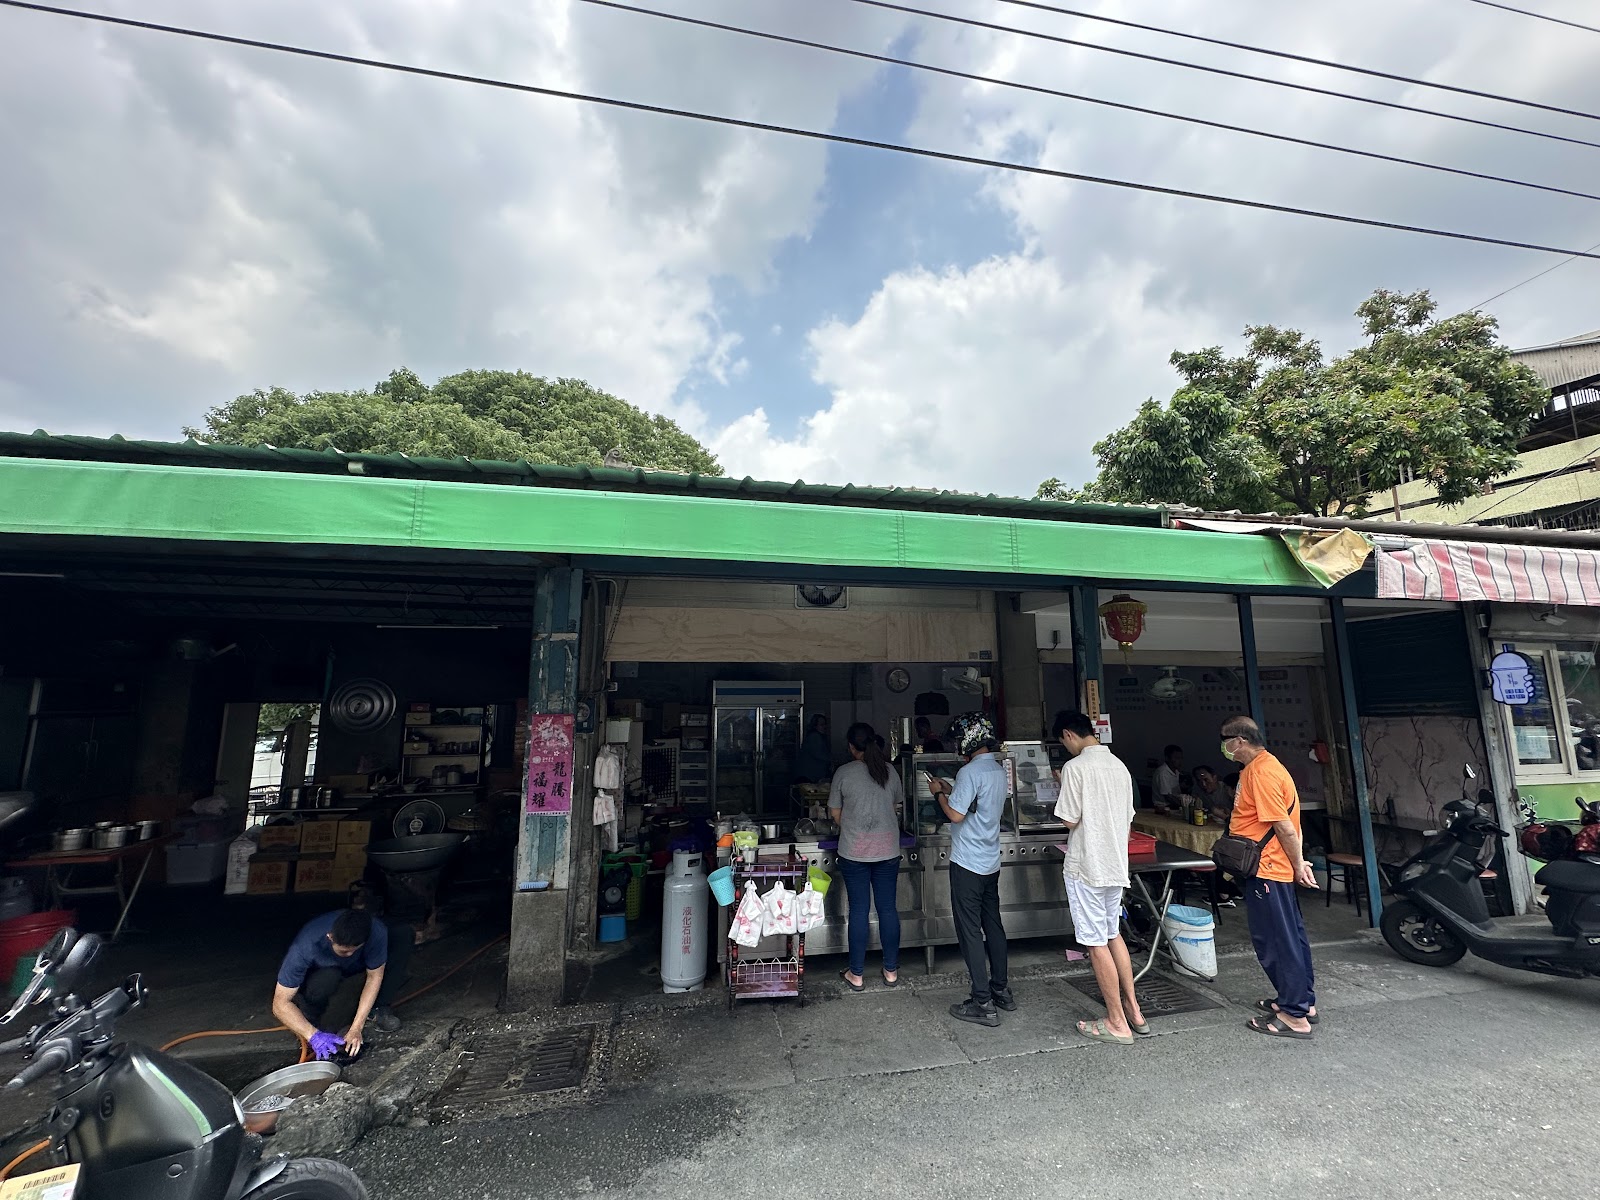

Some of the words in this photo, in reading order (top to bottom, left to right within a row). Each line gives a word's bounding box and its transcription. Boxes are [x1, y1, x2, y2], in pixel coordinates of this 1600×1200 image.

[531, 771, 548, 808] 福耀
[551, 761, 568, 798] 龍騰
[681, 906, 693, 955] 液化石油氣
